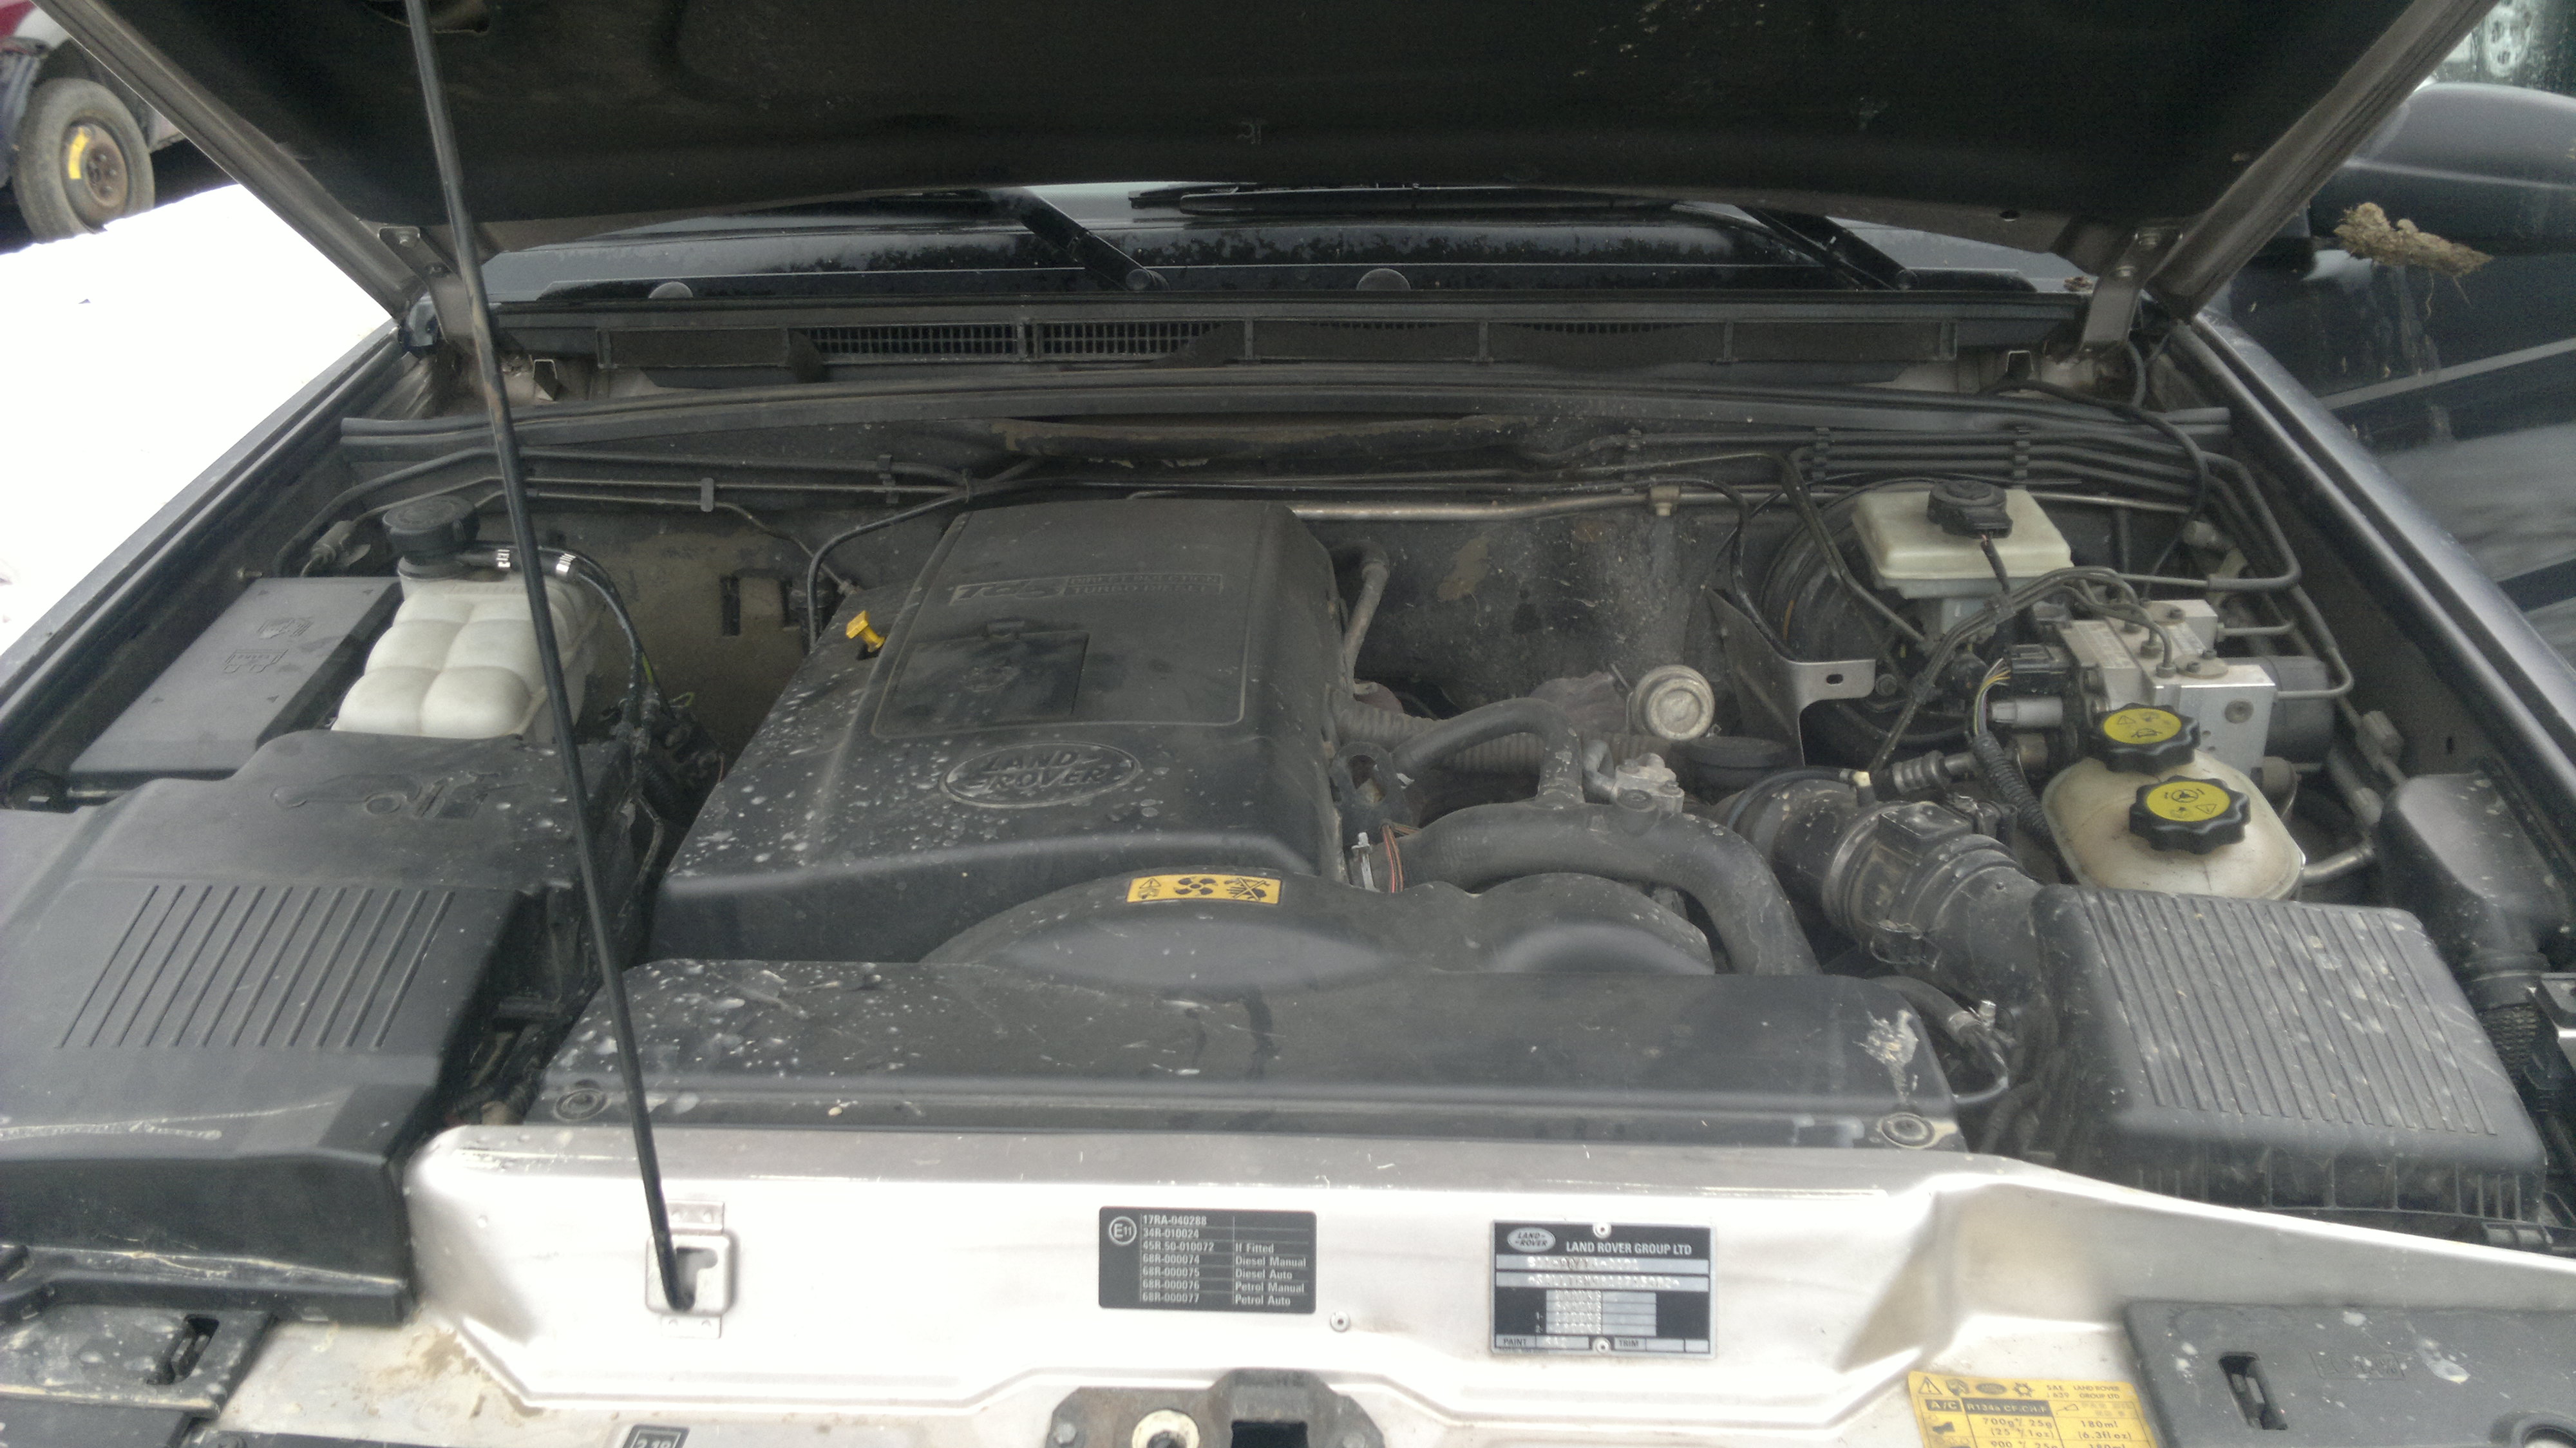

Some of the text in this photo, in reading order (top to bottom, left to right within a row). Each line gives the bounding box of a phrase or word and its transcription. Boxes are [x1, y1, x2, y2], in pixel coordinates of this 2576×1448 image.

[1143, 1214, 1207, 1226] 17RA-040288
[1143, 1227, 1199, 1238] 34R-010024
[1235, 1243, 1274, 1253] If Fitted
[1566, 1241, 1692, 1255] LAND ROVER GROUP LTD
[1142, 1253, 1200, 1264] 68R-000074
[1235, 1255, 1307, 1268] Diesel Manual
[1142, 1266, 1200, 1277] 68R-000075
[1235, 1268, 1293, 1279] Diesel Auto
[1142, 1279, 1200, 1290] 68R-000076
[1235, 1281, 1305, 1293] Petrol Manual
[1142, 1291, 1199, 1303] 68R-000077
[1235, 1293, 1291, 1306] Petrol Auto
[1933, 1400, 1957, 1410] A/C
